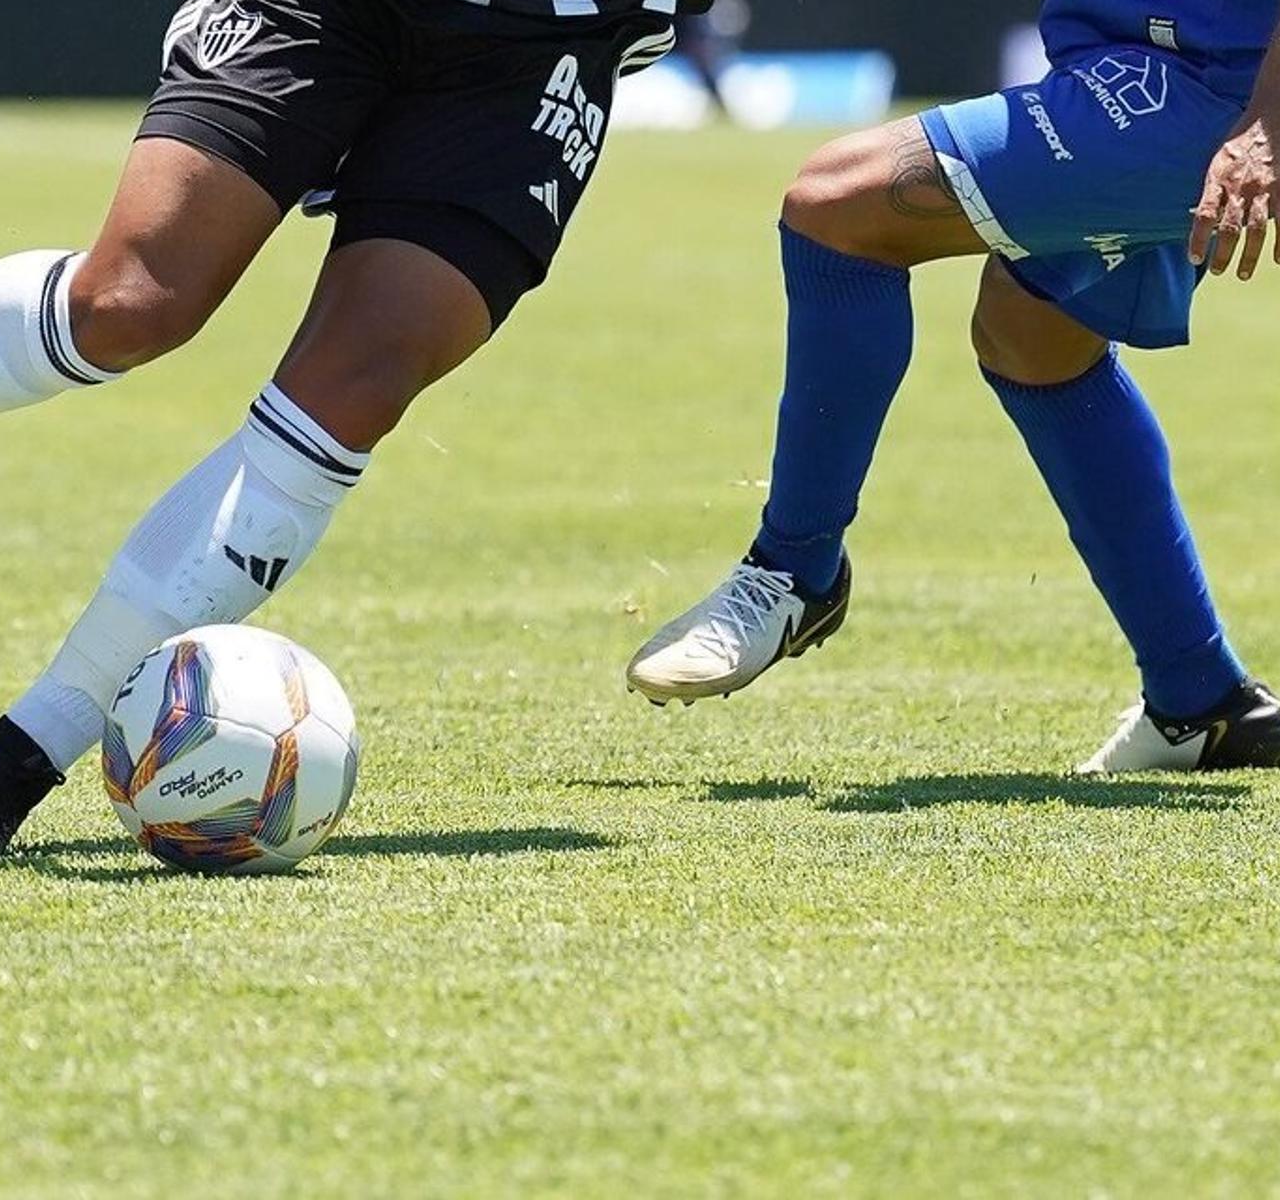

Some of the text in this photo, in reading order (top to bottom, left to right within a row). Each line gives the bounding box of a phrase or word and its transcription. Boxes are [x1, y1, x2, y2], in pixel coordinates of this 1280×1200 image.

[211, 19, 250, 32] CAM
[159, 770, 196, 797] PRO
[197, 769, 244, 800] CAMPO
